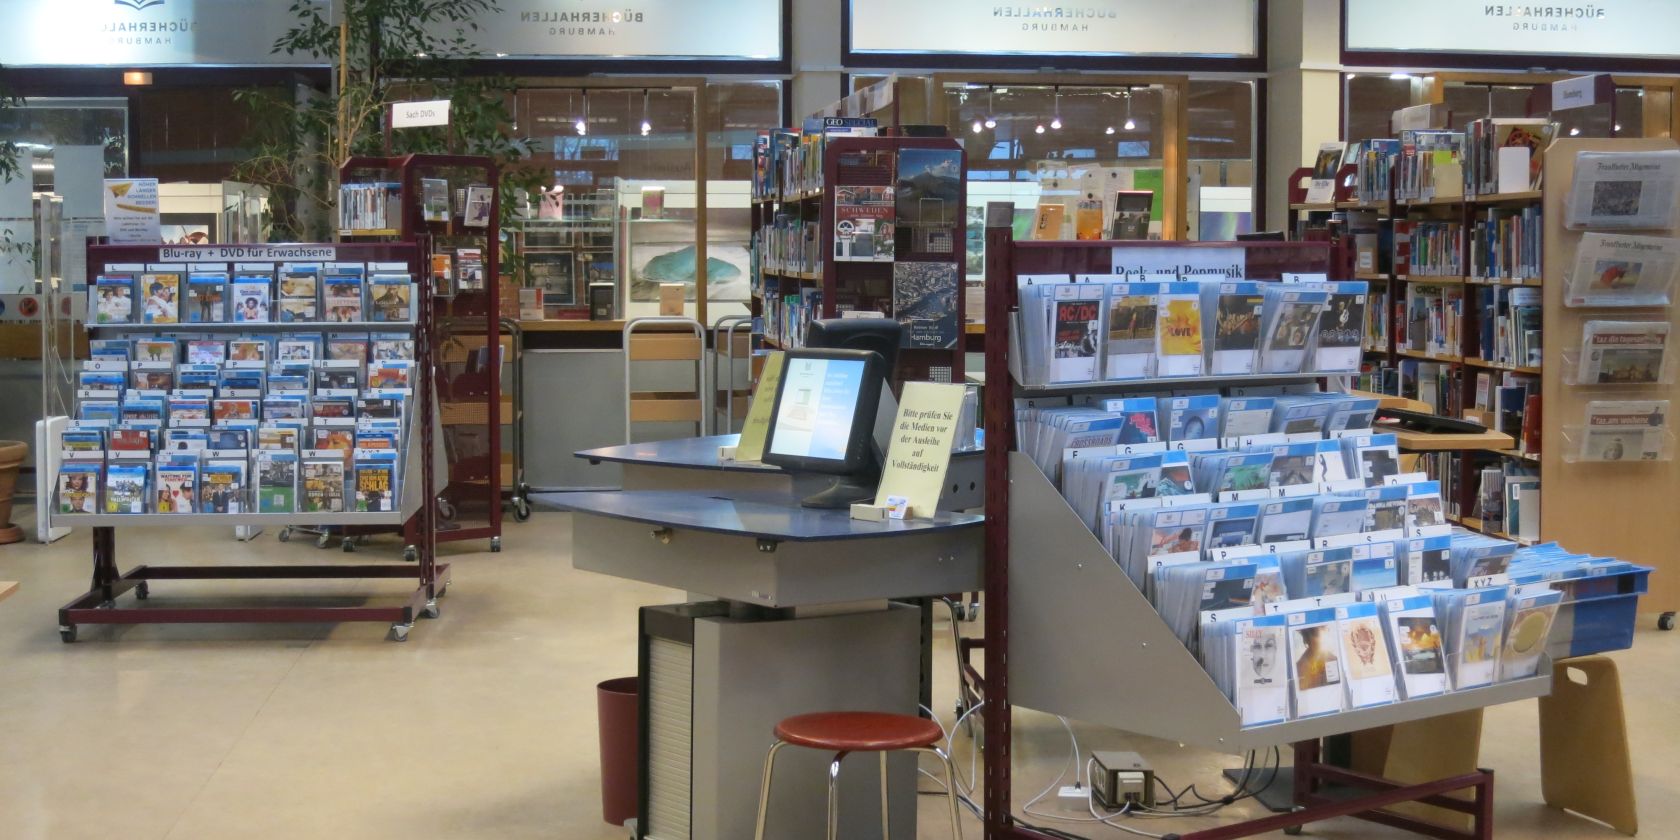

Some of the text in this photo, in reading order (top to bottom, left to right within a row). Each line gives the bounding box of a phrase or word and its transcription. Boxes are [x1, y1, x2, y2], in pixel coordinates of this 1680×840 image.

[406, 110, 420, 119] Sach
[826, 118, 843, 126] GEO
[163, 248, 201, 260] Blu-ray
[220, 248, 245, 258] DVD
[247, 247, 263, 258] für
[267, 246, 332, 258] Erwachsene
[1059, 305, 1097, 321] AC/DC
[1170, 327, 1191, 337] LOVE
[903, 409, 953, 421] Bitte prüfen Sie
[900, 421, 909, 430] die
[912, 421, 935, 432] Medien
[900, 434, 941, 446] der Ausleihe
[1070, 435, 1113, 448] CROSSROADS
[911, 448, 924, 457] auf
[1124, 446, 1132, 455] G
[892, 459, 940, 473] Vollständigkeit
[1231, 493, 1239, 501] M
[1278, 488, 1286, 497] M
[1119, 504, 1126, 512] K
[1315, 599, 1321, 607] T
[1210, 612, 1217, 623] S
